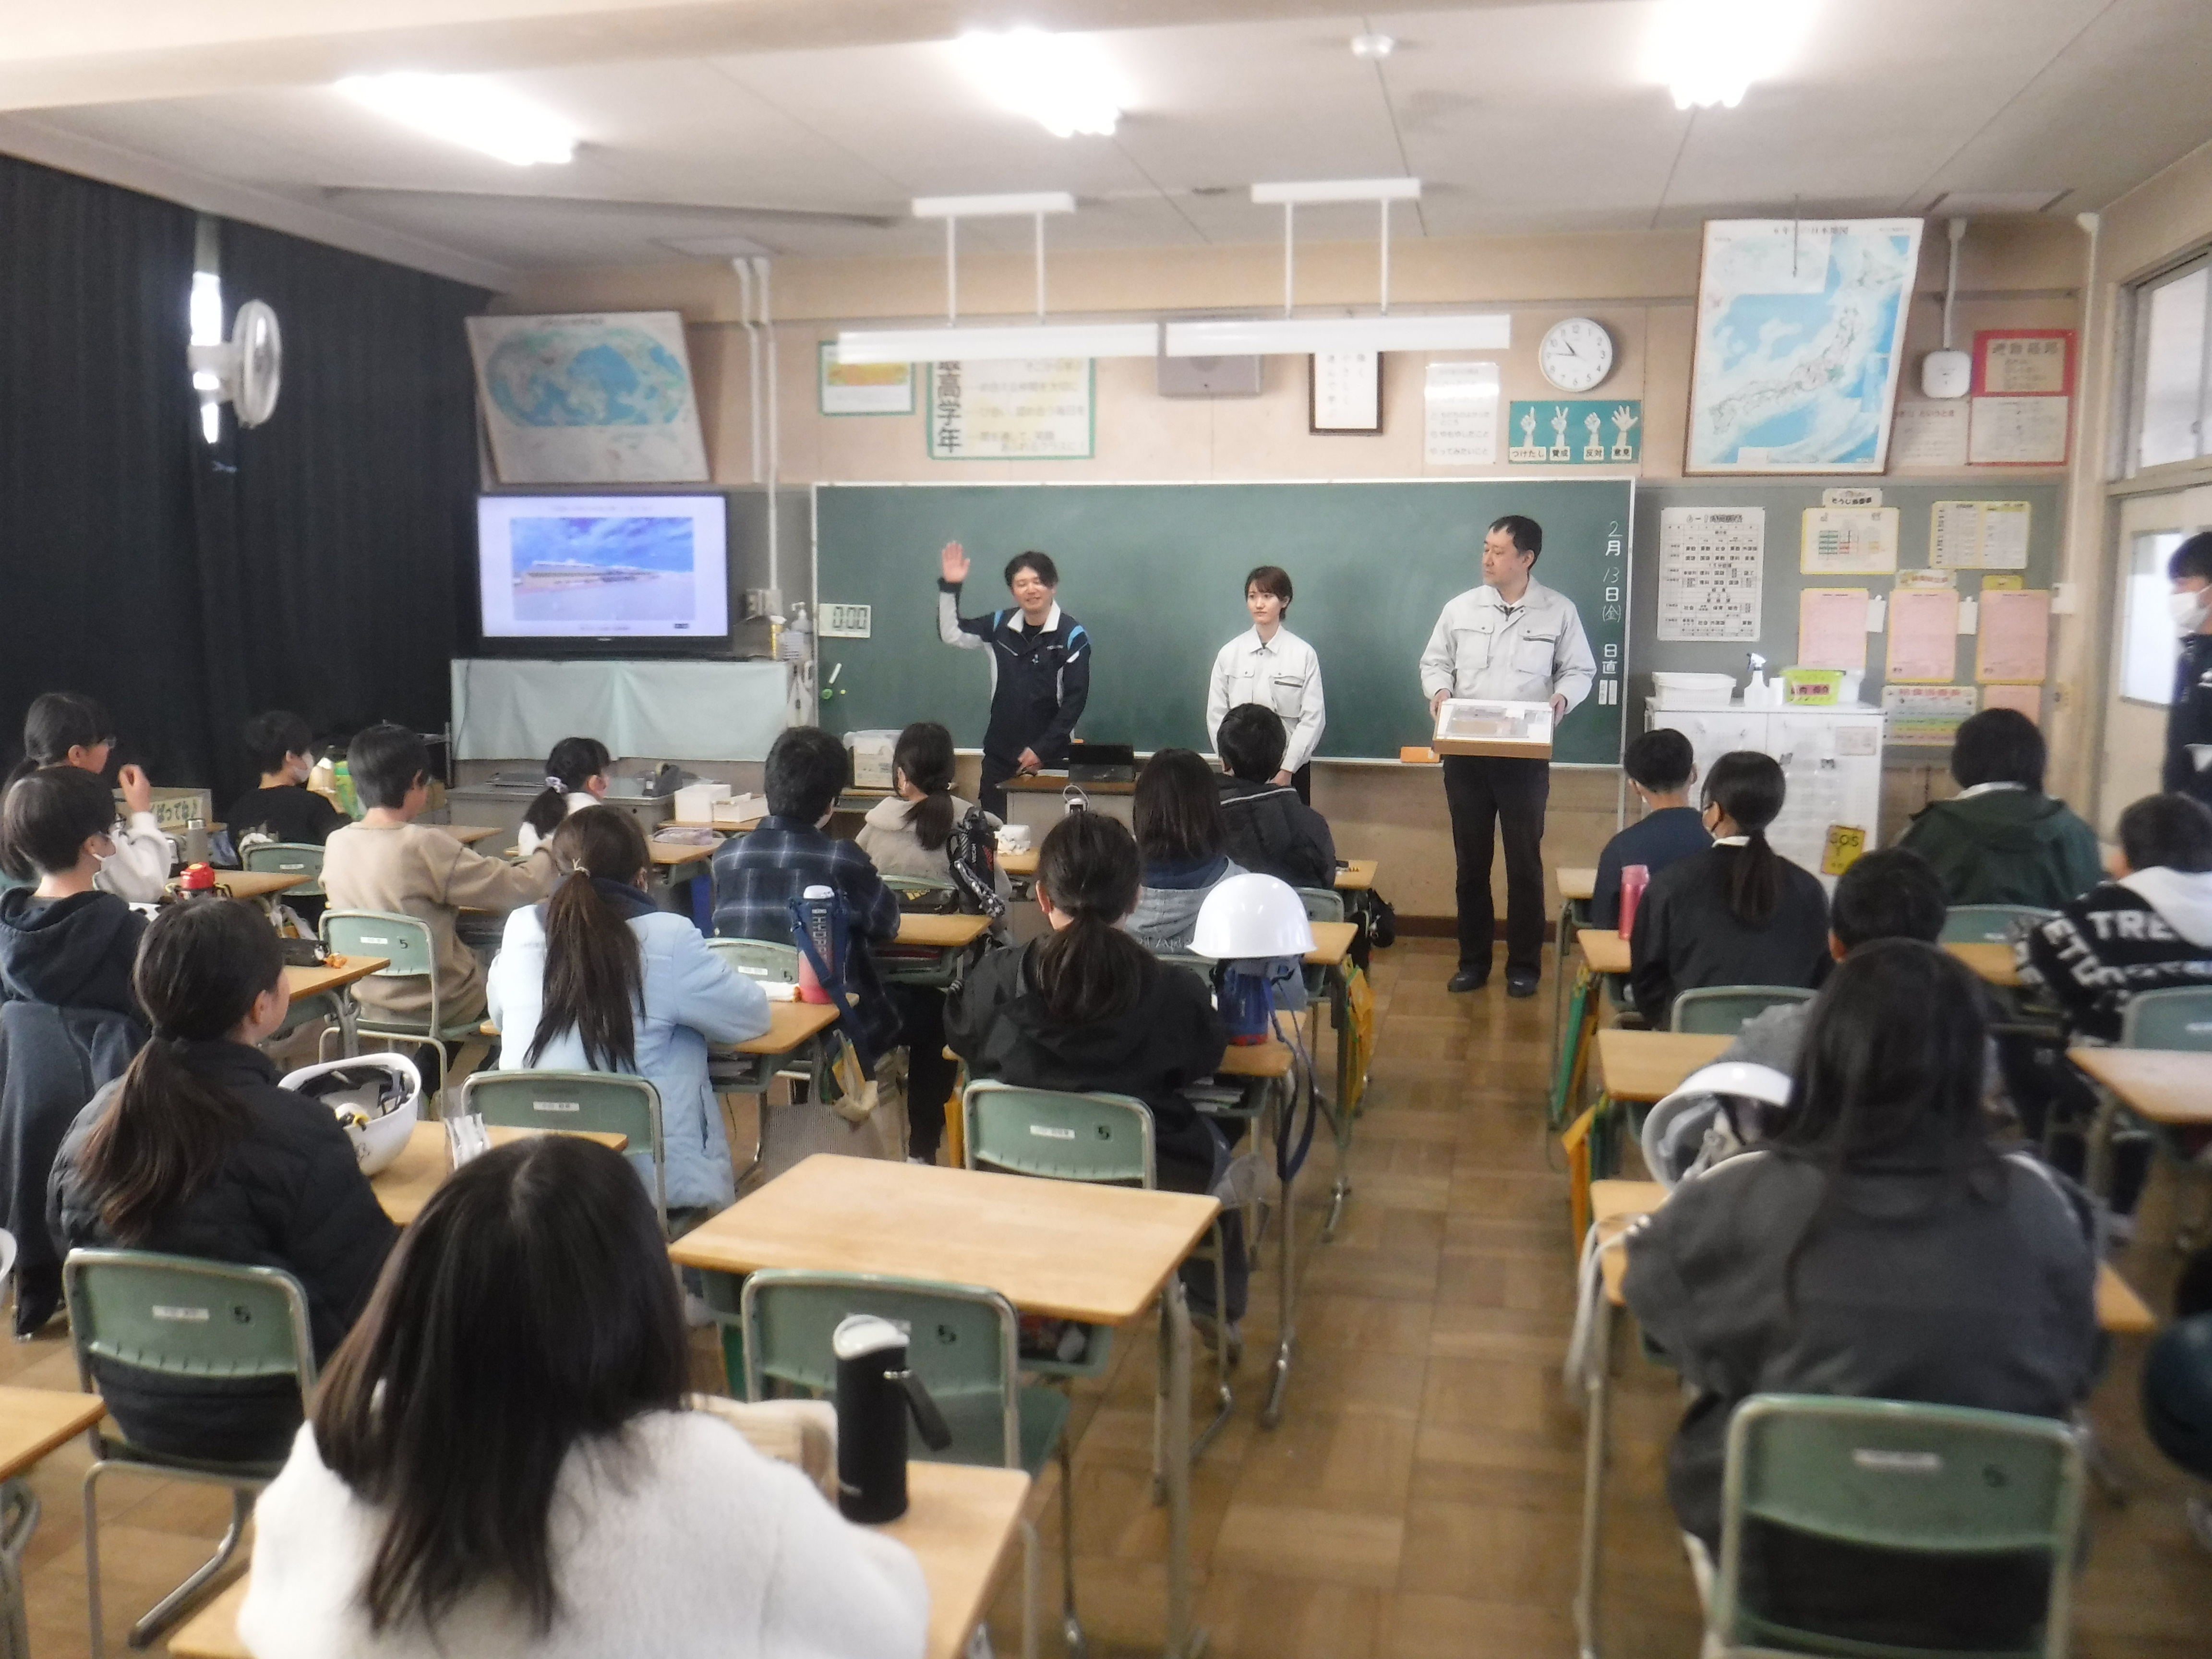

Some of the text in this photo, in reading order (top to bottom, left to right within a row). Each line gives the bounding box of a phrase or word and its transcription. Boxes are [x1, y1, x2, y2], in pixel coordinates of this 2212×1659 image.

[1512, 450, 1544, 458] つけたし
[1586, 449, 1602, 457] 反対
[1602, 644, 1618, 674] 日直
[399, 939, 409, 950] 5
